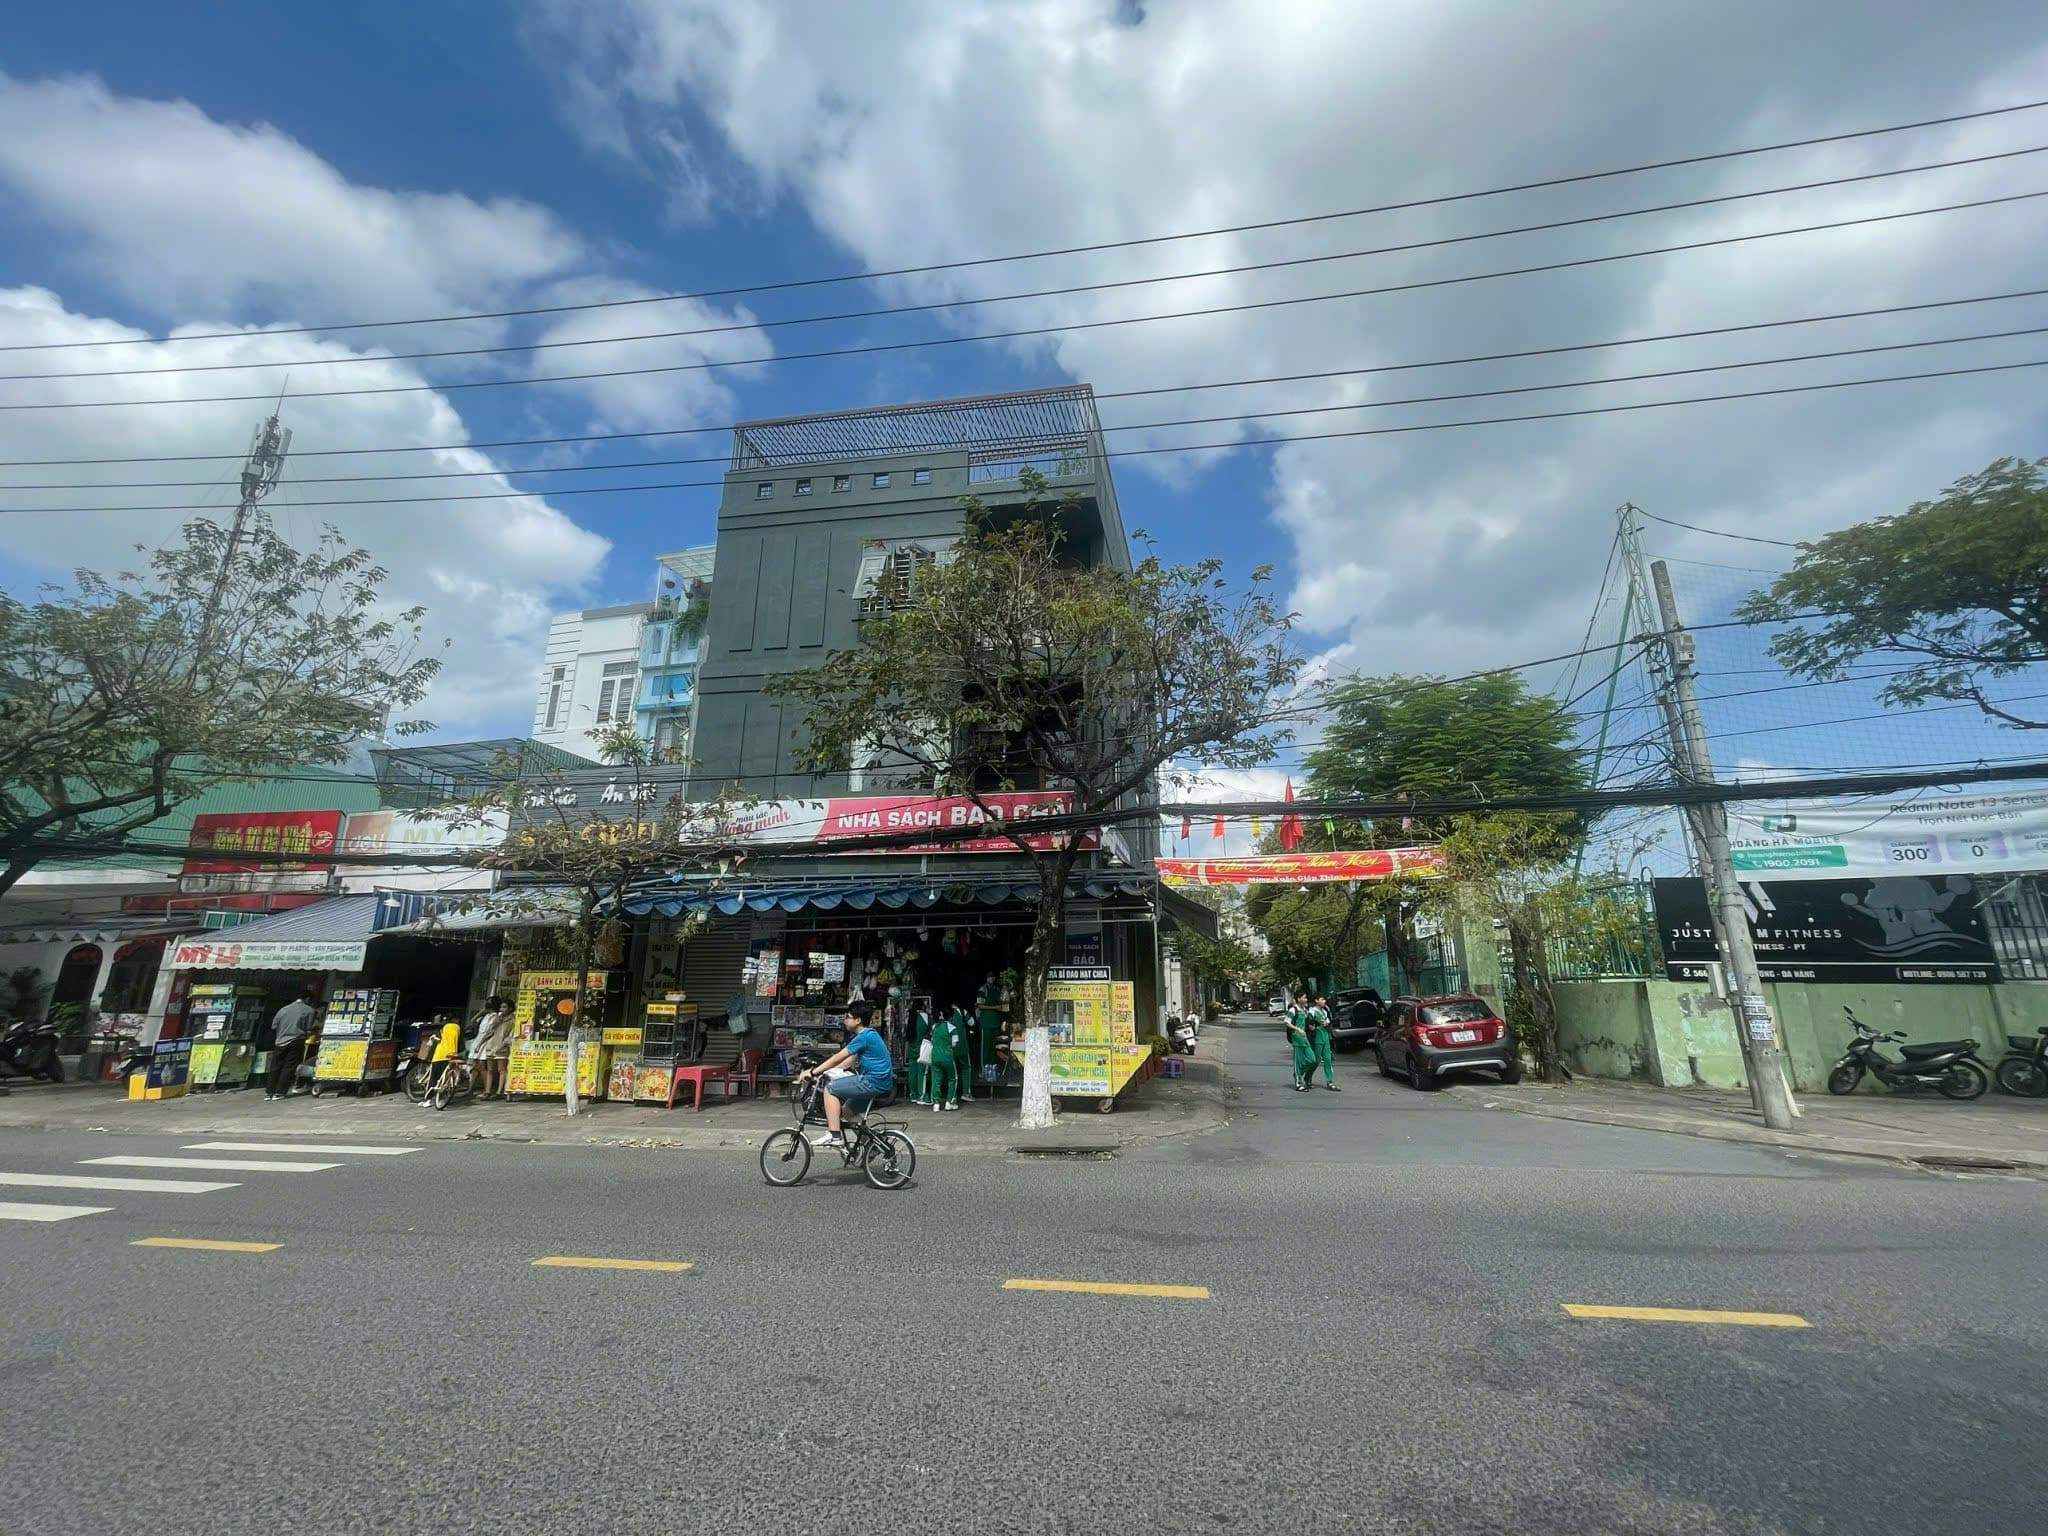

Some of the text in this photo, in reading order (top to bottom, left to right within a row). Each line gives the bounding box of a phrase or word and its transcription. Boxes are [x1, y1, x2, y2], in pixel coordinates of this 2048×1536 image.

[600, 776, 624, 803] Ăn
[1889, 794, 2048, 814] Redmi Note 13 Series
[838, 809, 881, 828] NHÀ
[887, 808, 942, 827] SÁCH
[1918, 816, 1944, 826] Trọn
[1728, 836, 1769, 849] HOÀNG
[1793, 834, 1840, 846] MOBILE
[1672, 929, 1713, 938] JUST
[1775, 929, 1842, 938] FITNESS
[1092, 968, 1108, 979] CHIA
